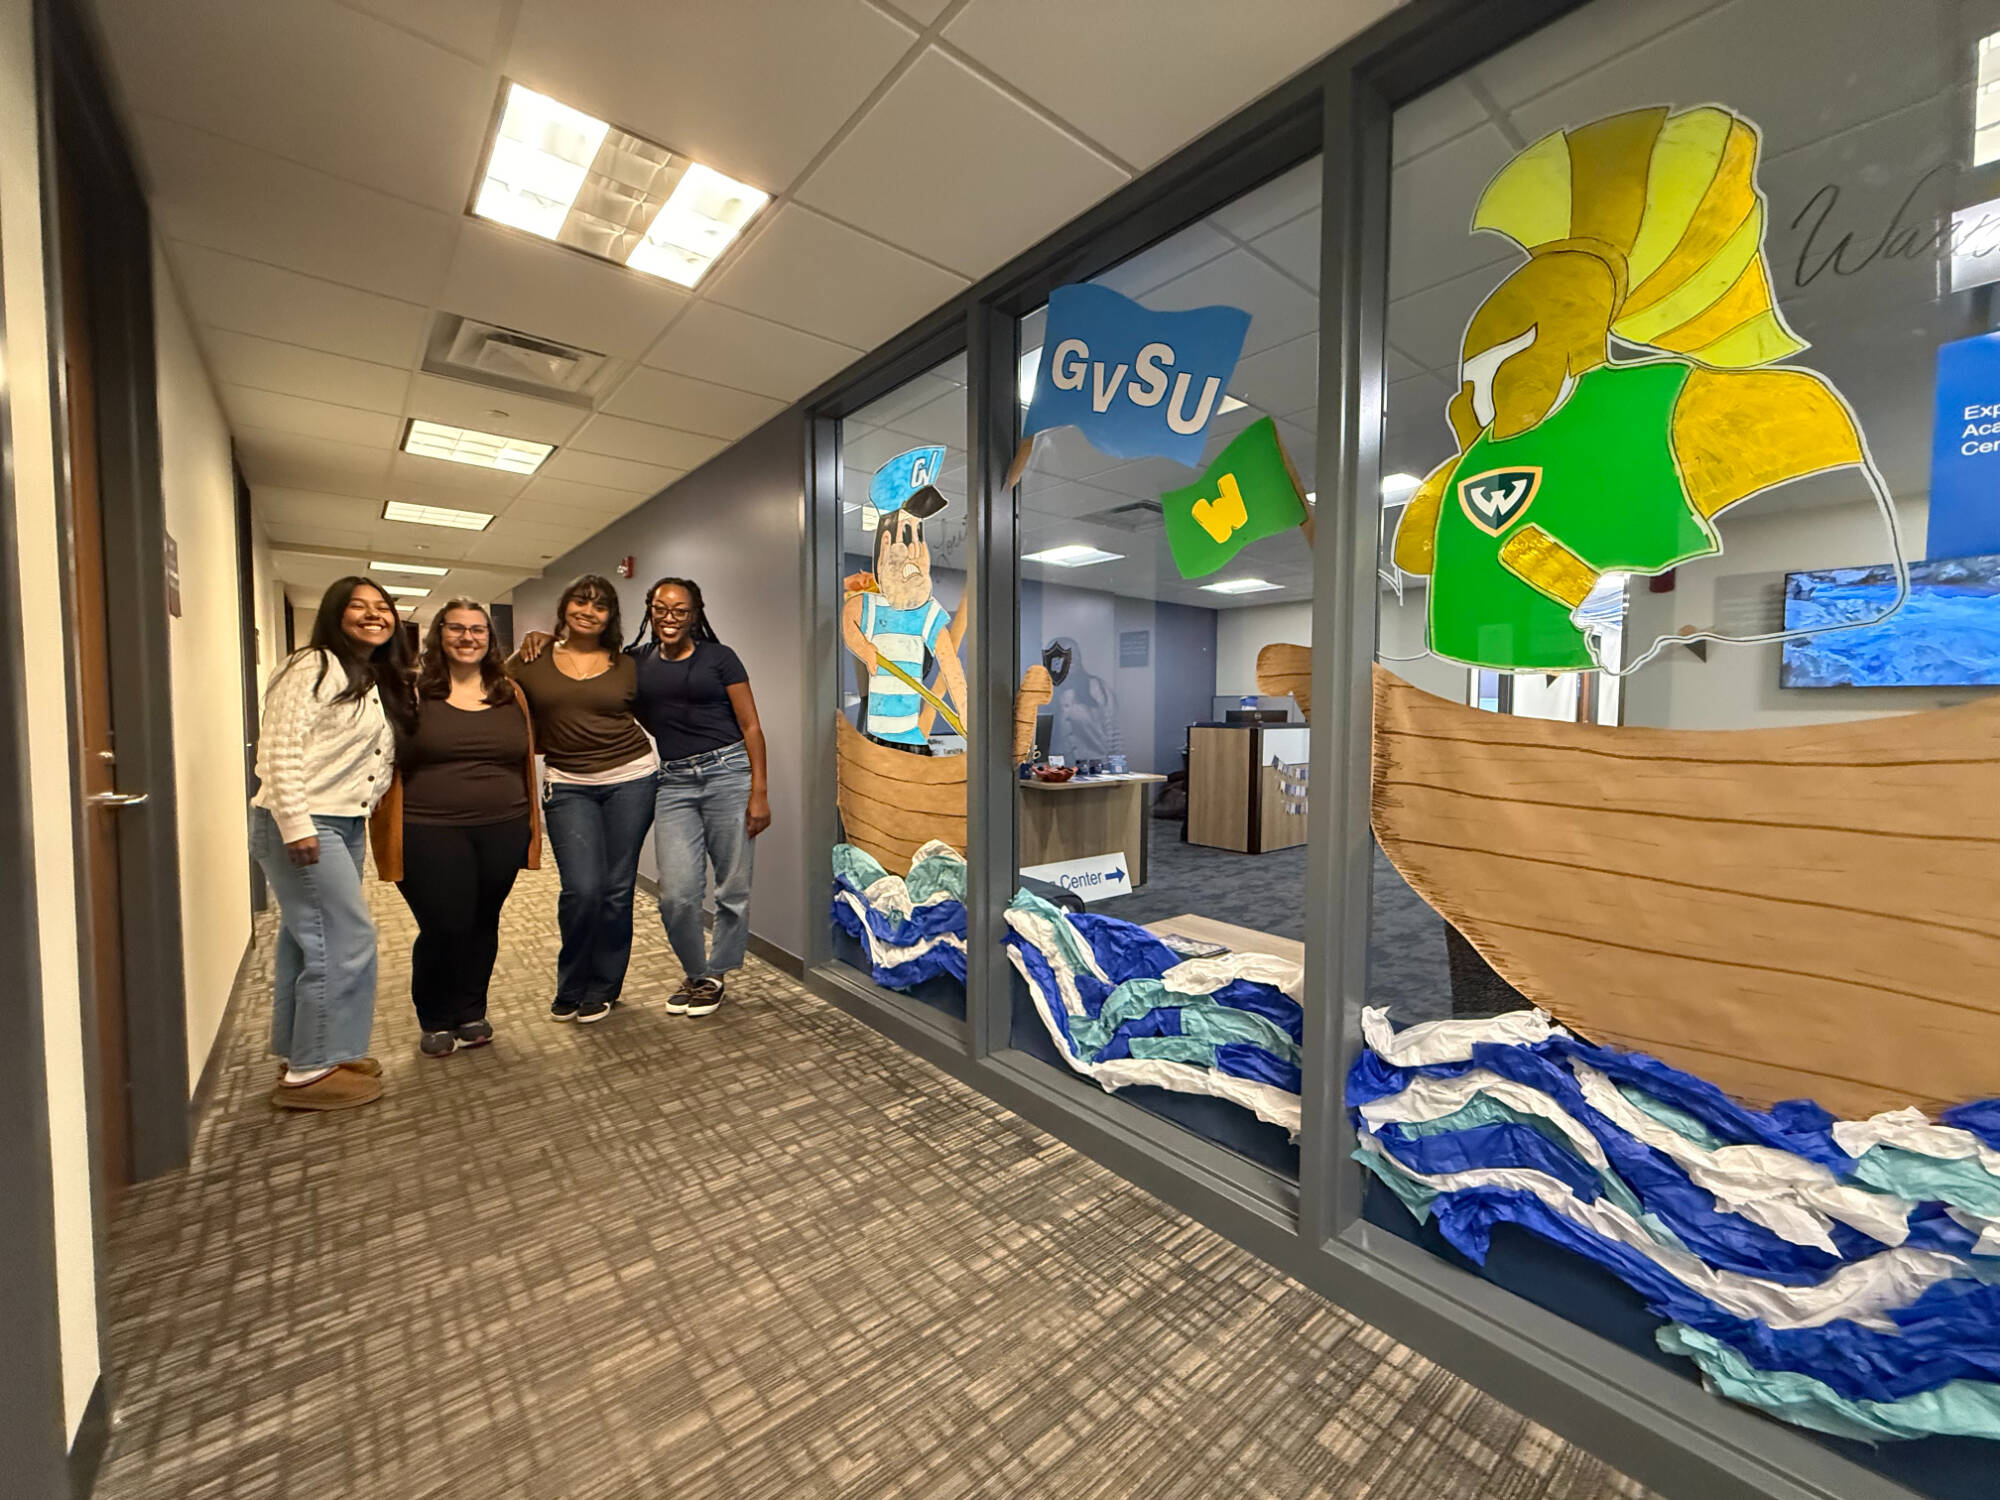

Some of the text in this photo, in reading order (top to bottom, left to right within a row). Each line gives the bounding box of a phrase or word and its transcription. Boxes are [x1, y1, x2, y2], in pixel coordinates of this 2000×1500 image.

[1052, 338, 1221, 435] GVSU
[1470, 478, 1528, 518] W
[1059, 872, 1102, 890] Center
